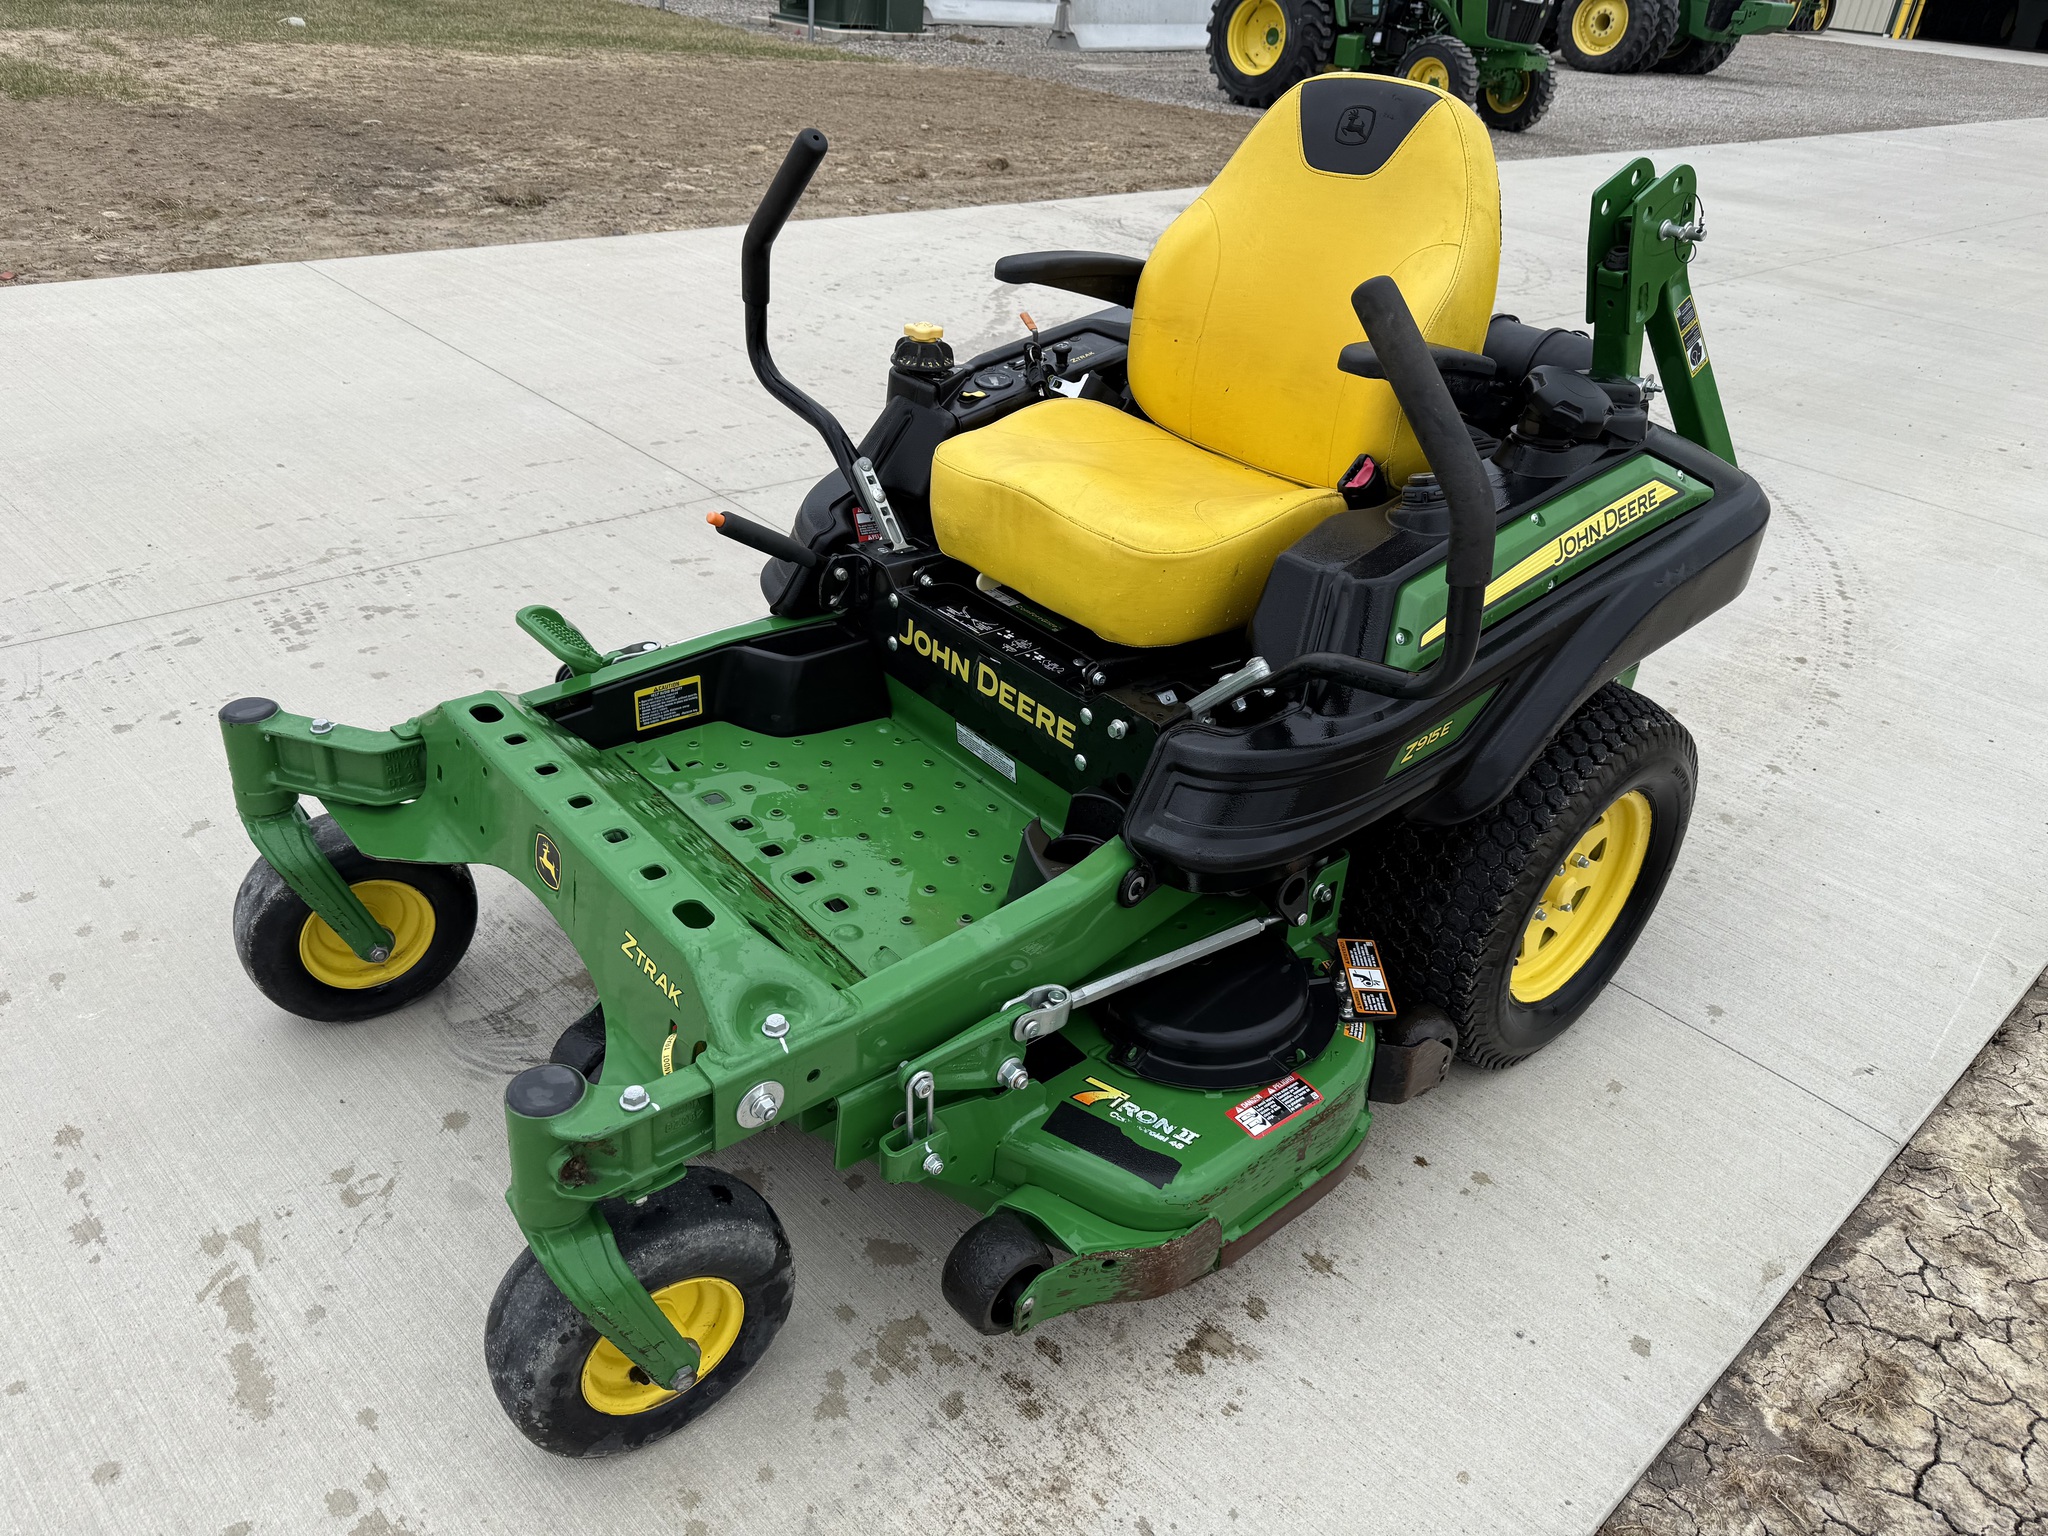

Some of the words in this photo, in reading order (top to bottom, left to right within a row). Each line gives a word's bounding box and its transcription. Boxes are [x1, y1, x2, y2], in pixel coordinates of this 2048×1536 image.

[1554, 520, 1601, 564] JOHN
[1604, 487, 1658, 534] DEERE
[658, 681, 680, 691] CAUTION
[899, 618, 970, 684] JOHN
[977, 661, 1077, 750] DEERE
[1400, 720, 1454, 764] Z915E
[620, 929, 685, 1011] ZTRAK
[1240, 1093, 1264, 1108] DANGER
